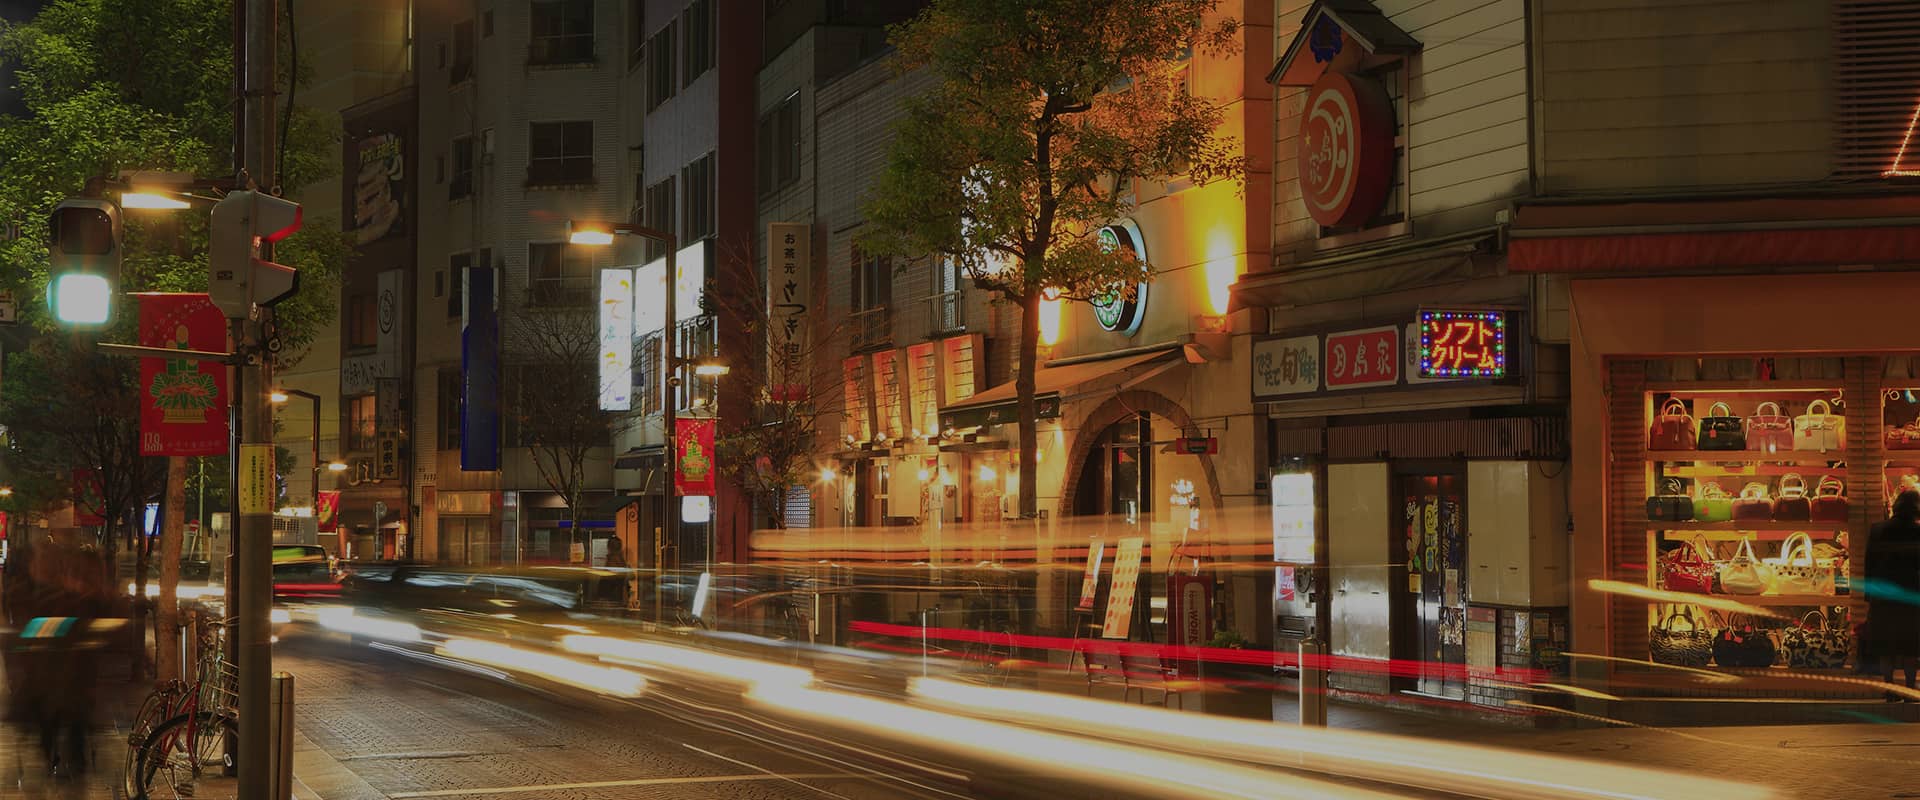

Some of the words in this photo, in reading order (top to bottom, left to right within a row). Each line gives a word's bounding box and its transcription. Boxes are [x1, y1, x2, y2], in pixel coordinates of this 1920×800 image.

[1432, 321, 1493, 345] ソフト
[1432, 345, 1495, 369] クリーム
